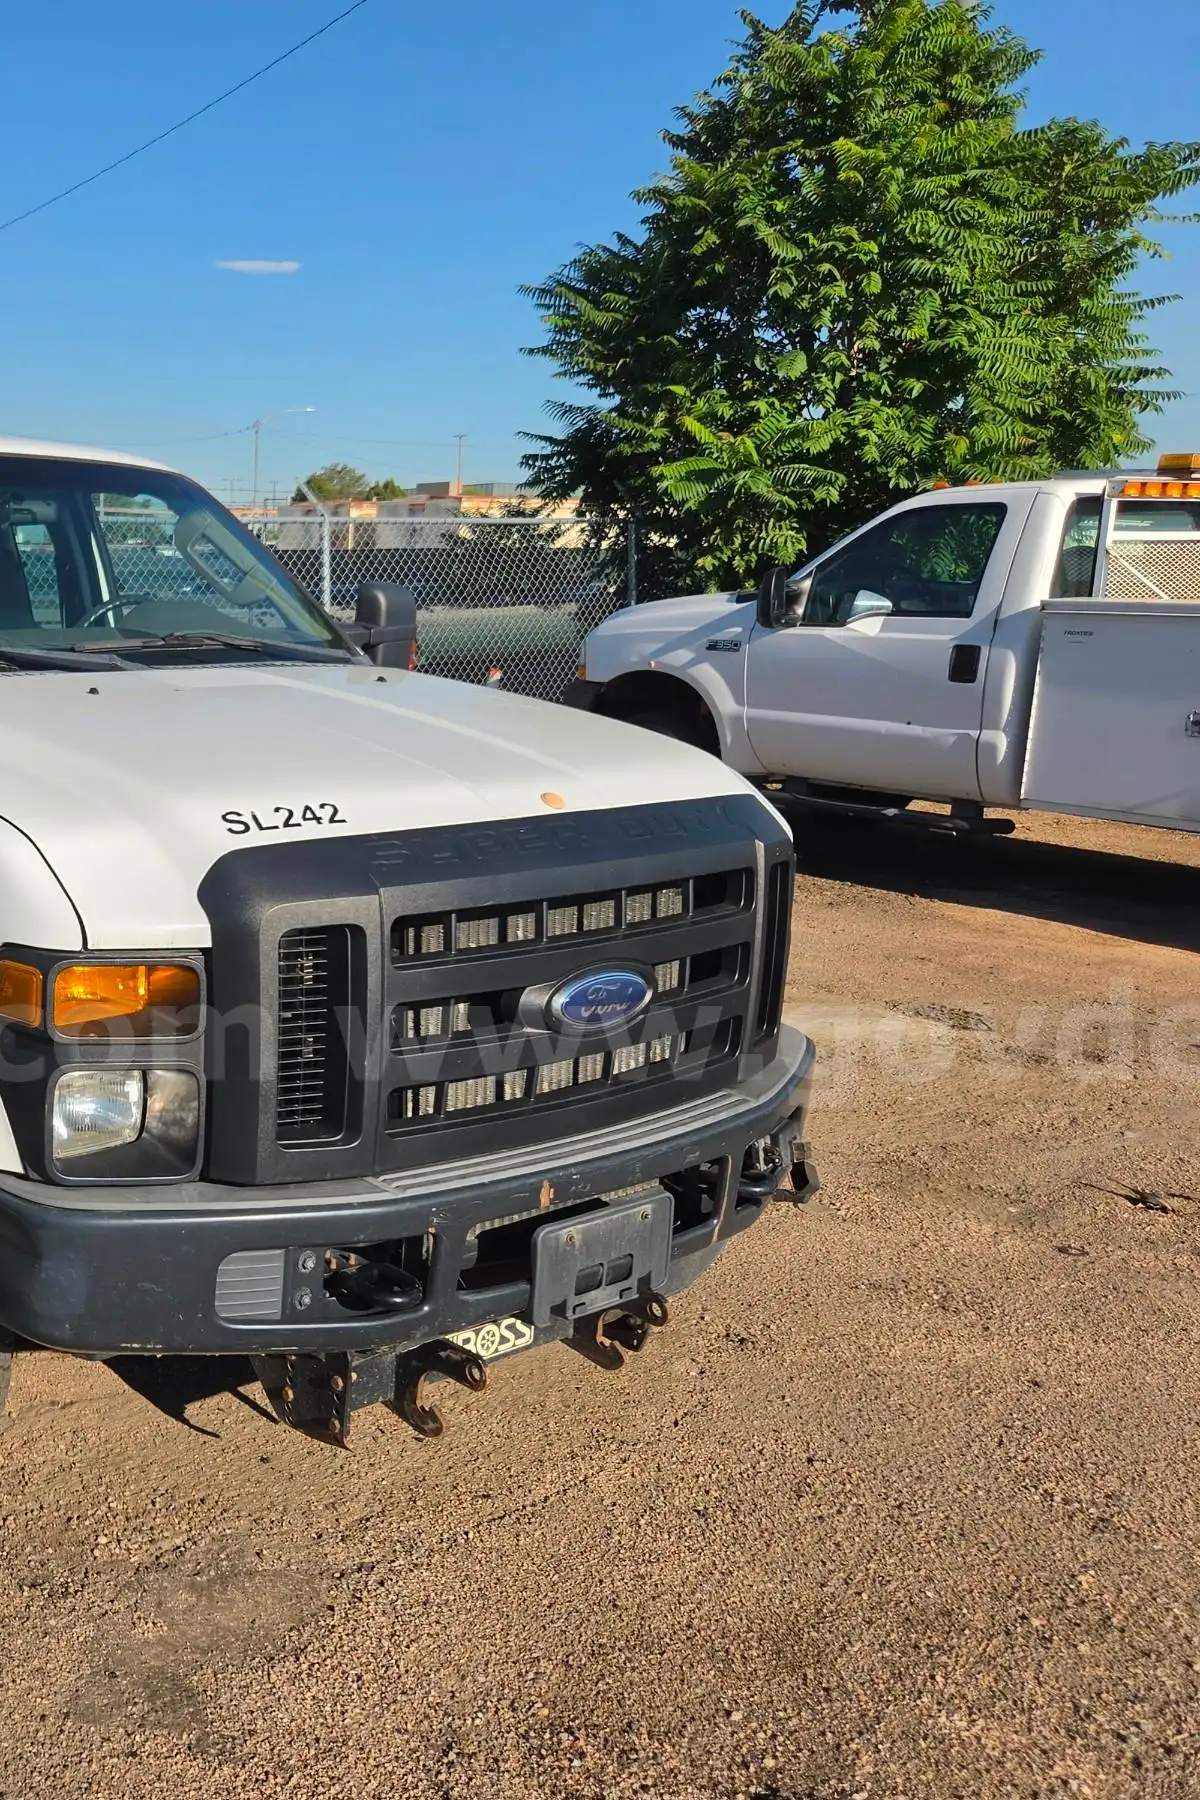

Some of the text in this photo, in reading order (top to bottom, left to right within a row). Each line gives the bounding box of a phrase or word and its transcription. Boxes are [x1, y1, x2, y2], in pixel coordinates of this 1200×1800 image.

[220, 802, 349, 836] SL242
[366, 804, 742, 866] SUPER DUTY
[579, 981, 634, 1018] Ford
